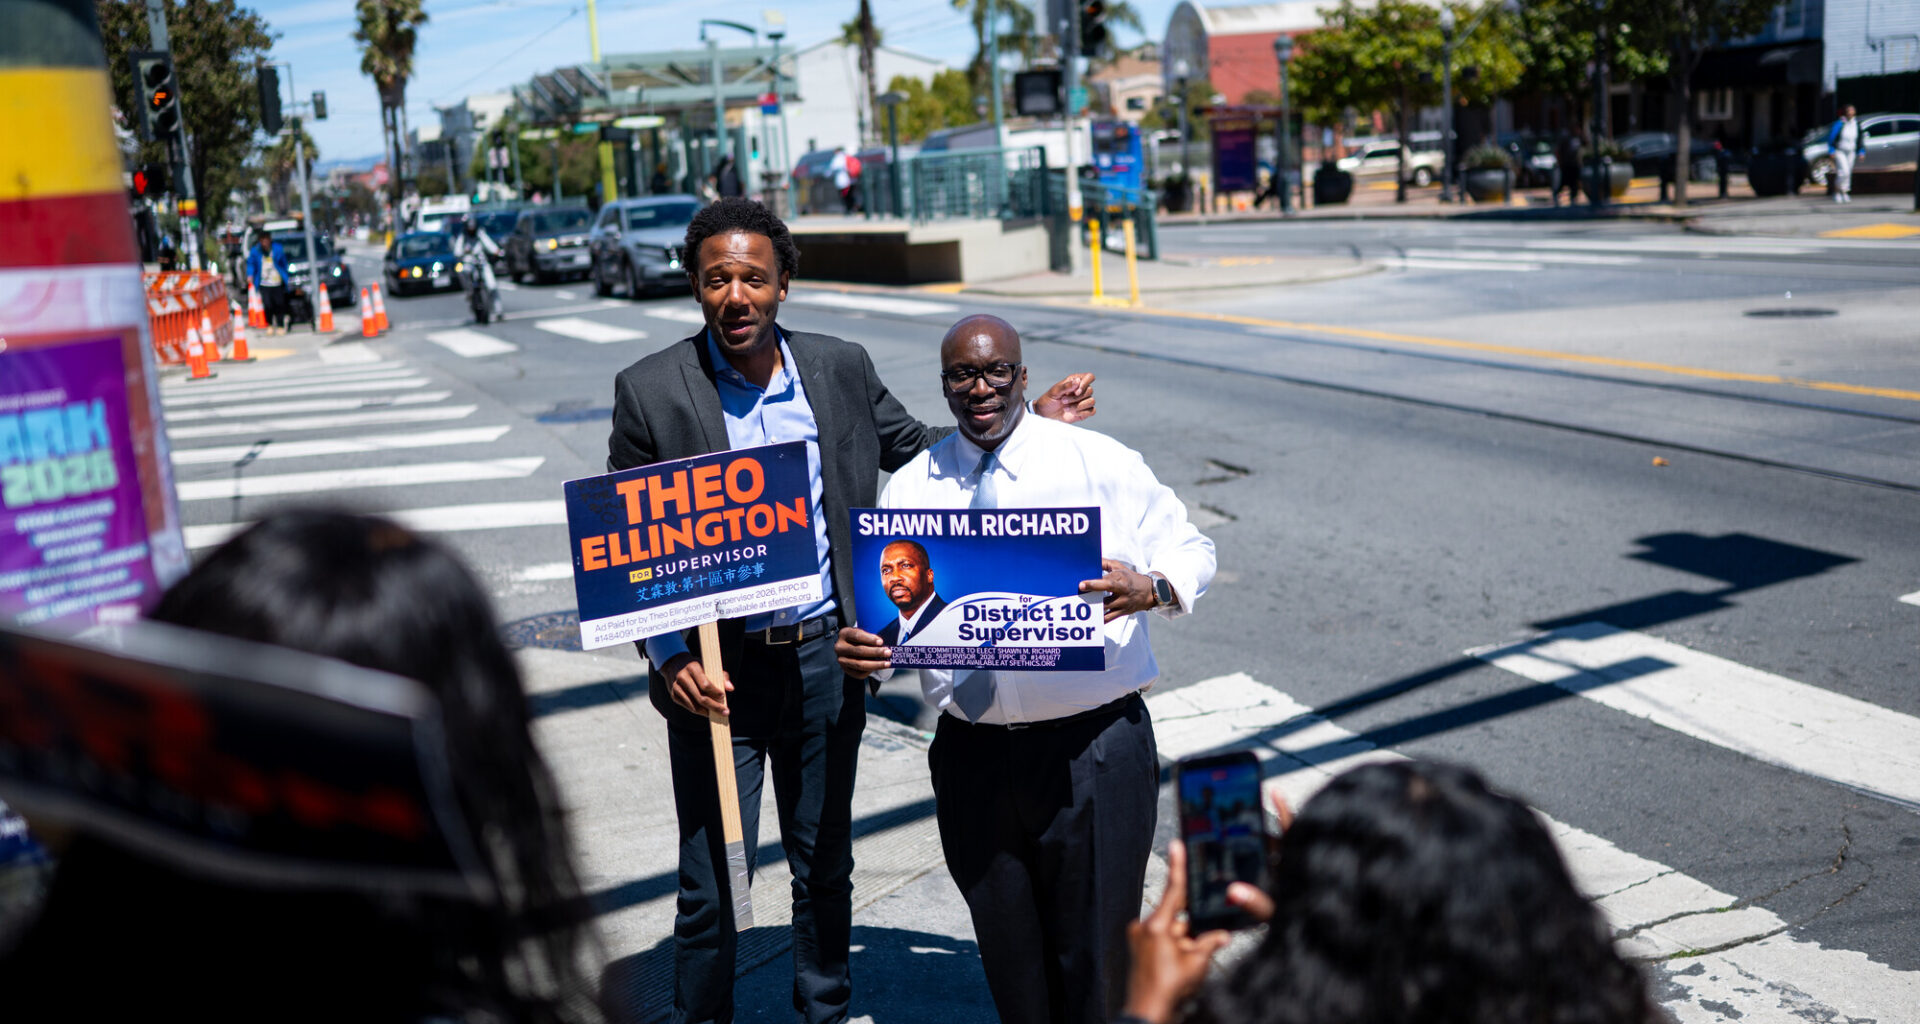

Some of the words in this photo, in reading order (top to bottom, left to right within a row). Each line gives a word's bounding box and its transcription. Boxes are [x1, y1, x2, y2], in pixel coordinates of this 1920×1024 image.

[616, 457, 765, 525] THEO
[581, 497, 808, 571] ELLINGTON
[858, 513, 943, 536] SHAWN
[950, 514, 977, 536] M.
[982, 513, 1089, 536] RICHARD
[631, 570, 651, 581] FOR
[656, 544, 767, 577] SUPERVISOR
[595, 624, 607, 632] Ad
[608, 619, 625, 630] Paid
[638, 615, 648, 624] by
[650, 613, 668, 621] Theo
[669, 603, 702, 617] Ellington
[702, 601, 713, 609] for
[714, 592, 755, 606] Supervisor
[778, 582, 800, 593] FPPC
[801, 581, 809, 589] ID
[637, 621, 669, 633] Financial
[670, 612, 711, 626] disclosures
[725, 602, 759, 615] available
[768, 593, 811, 608] sfethics.org
[963, 603, 1054, 622] District
[1061, 603, 1091, 621] 10
[1019, 595, 1032, 603] for
[958, 623, 1096, 645] Supervisor
